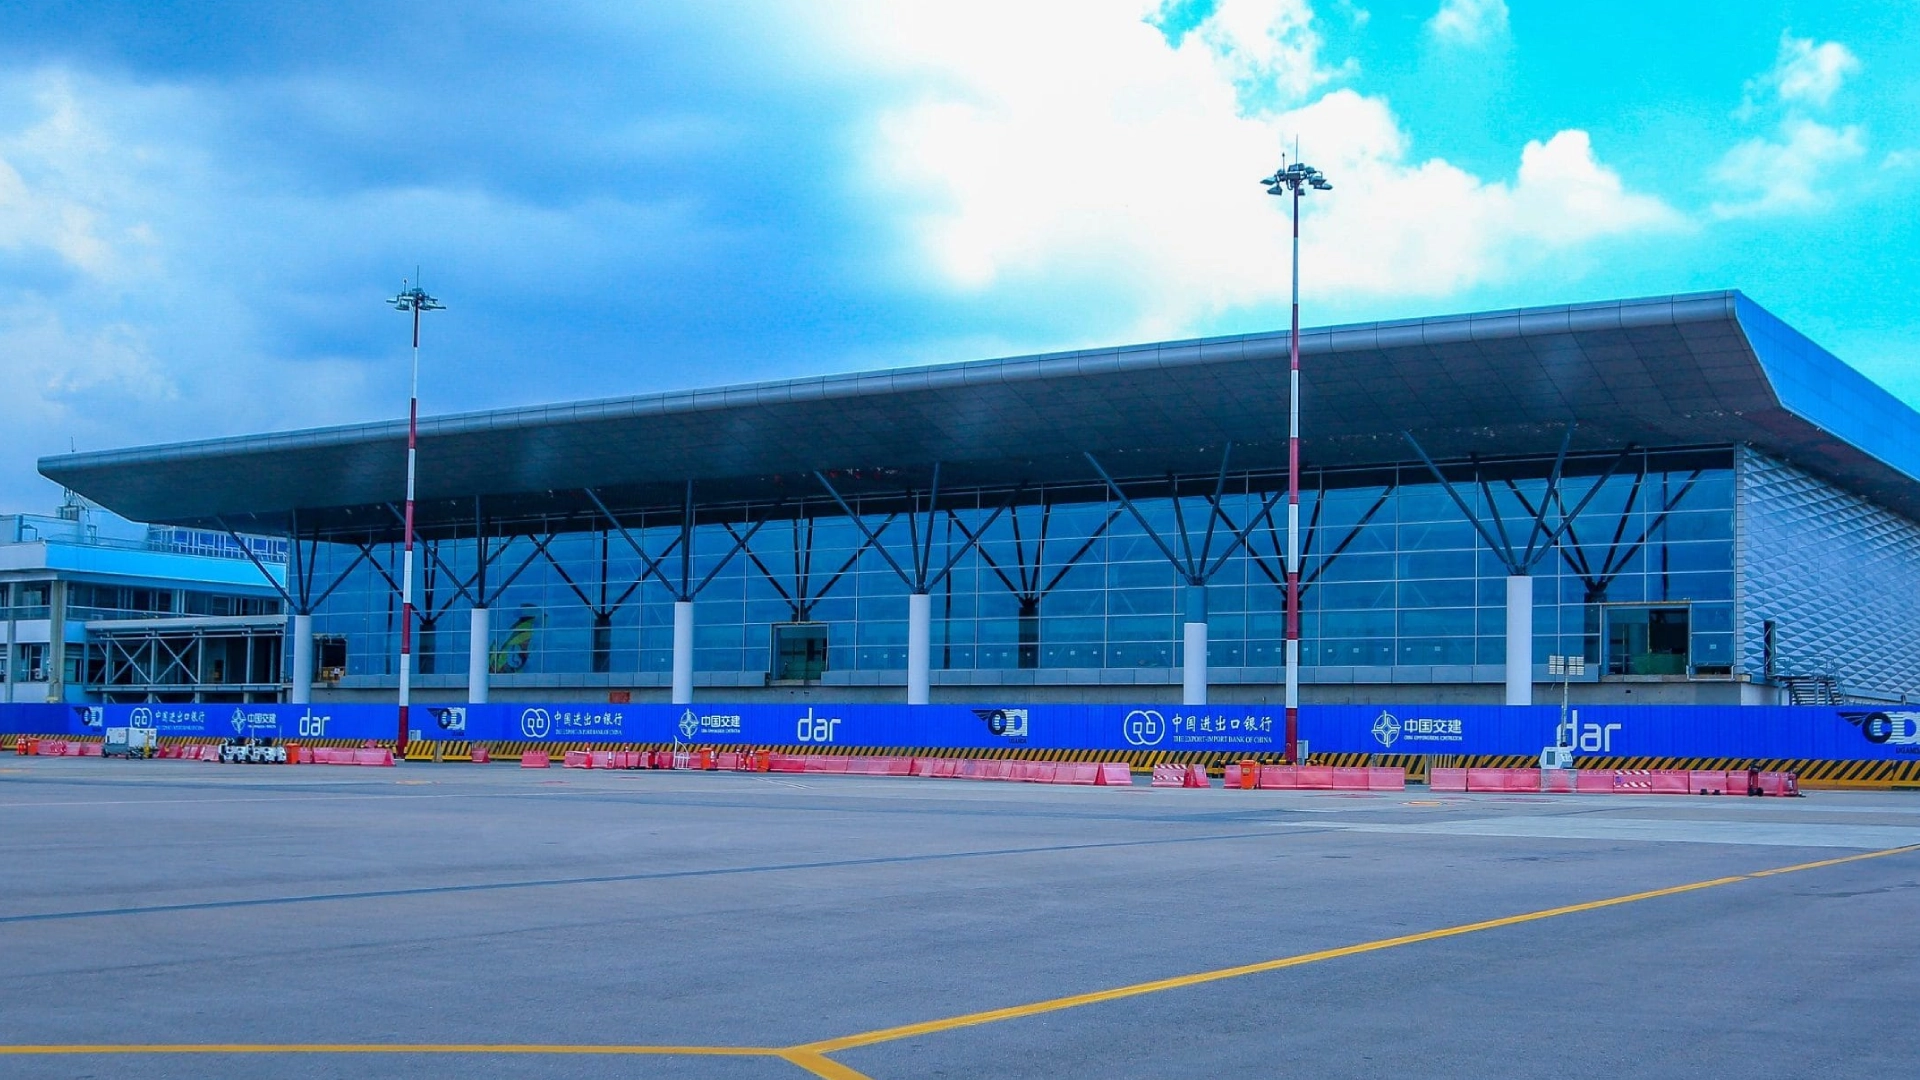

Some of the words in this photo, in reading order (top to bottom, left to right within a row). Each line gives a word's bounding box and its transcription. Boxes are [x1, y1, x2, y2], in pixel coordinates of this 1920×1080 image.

[299, 707, 331, 736] dar
[701, 715, 740, 728] 中国交建
[797, 707, 841, 742] dar
[1172, 713, 1273, 733] 中国进出口银行
[1404, 719, 1462, 734] 中国交建
[1557, 710, 1621, 752] dar
